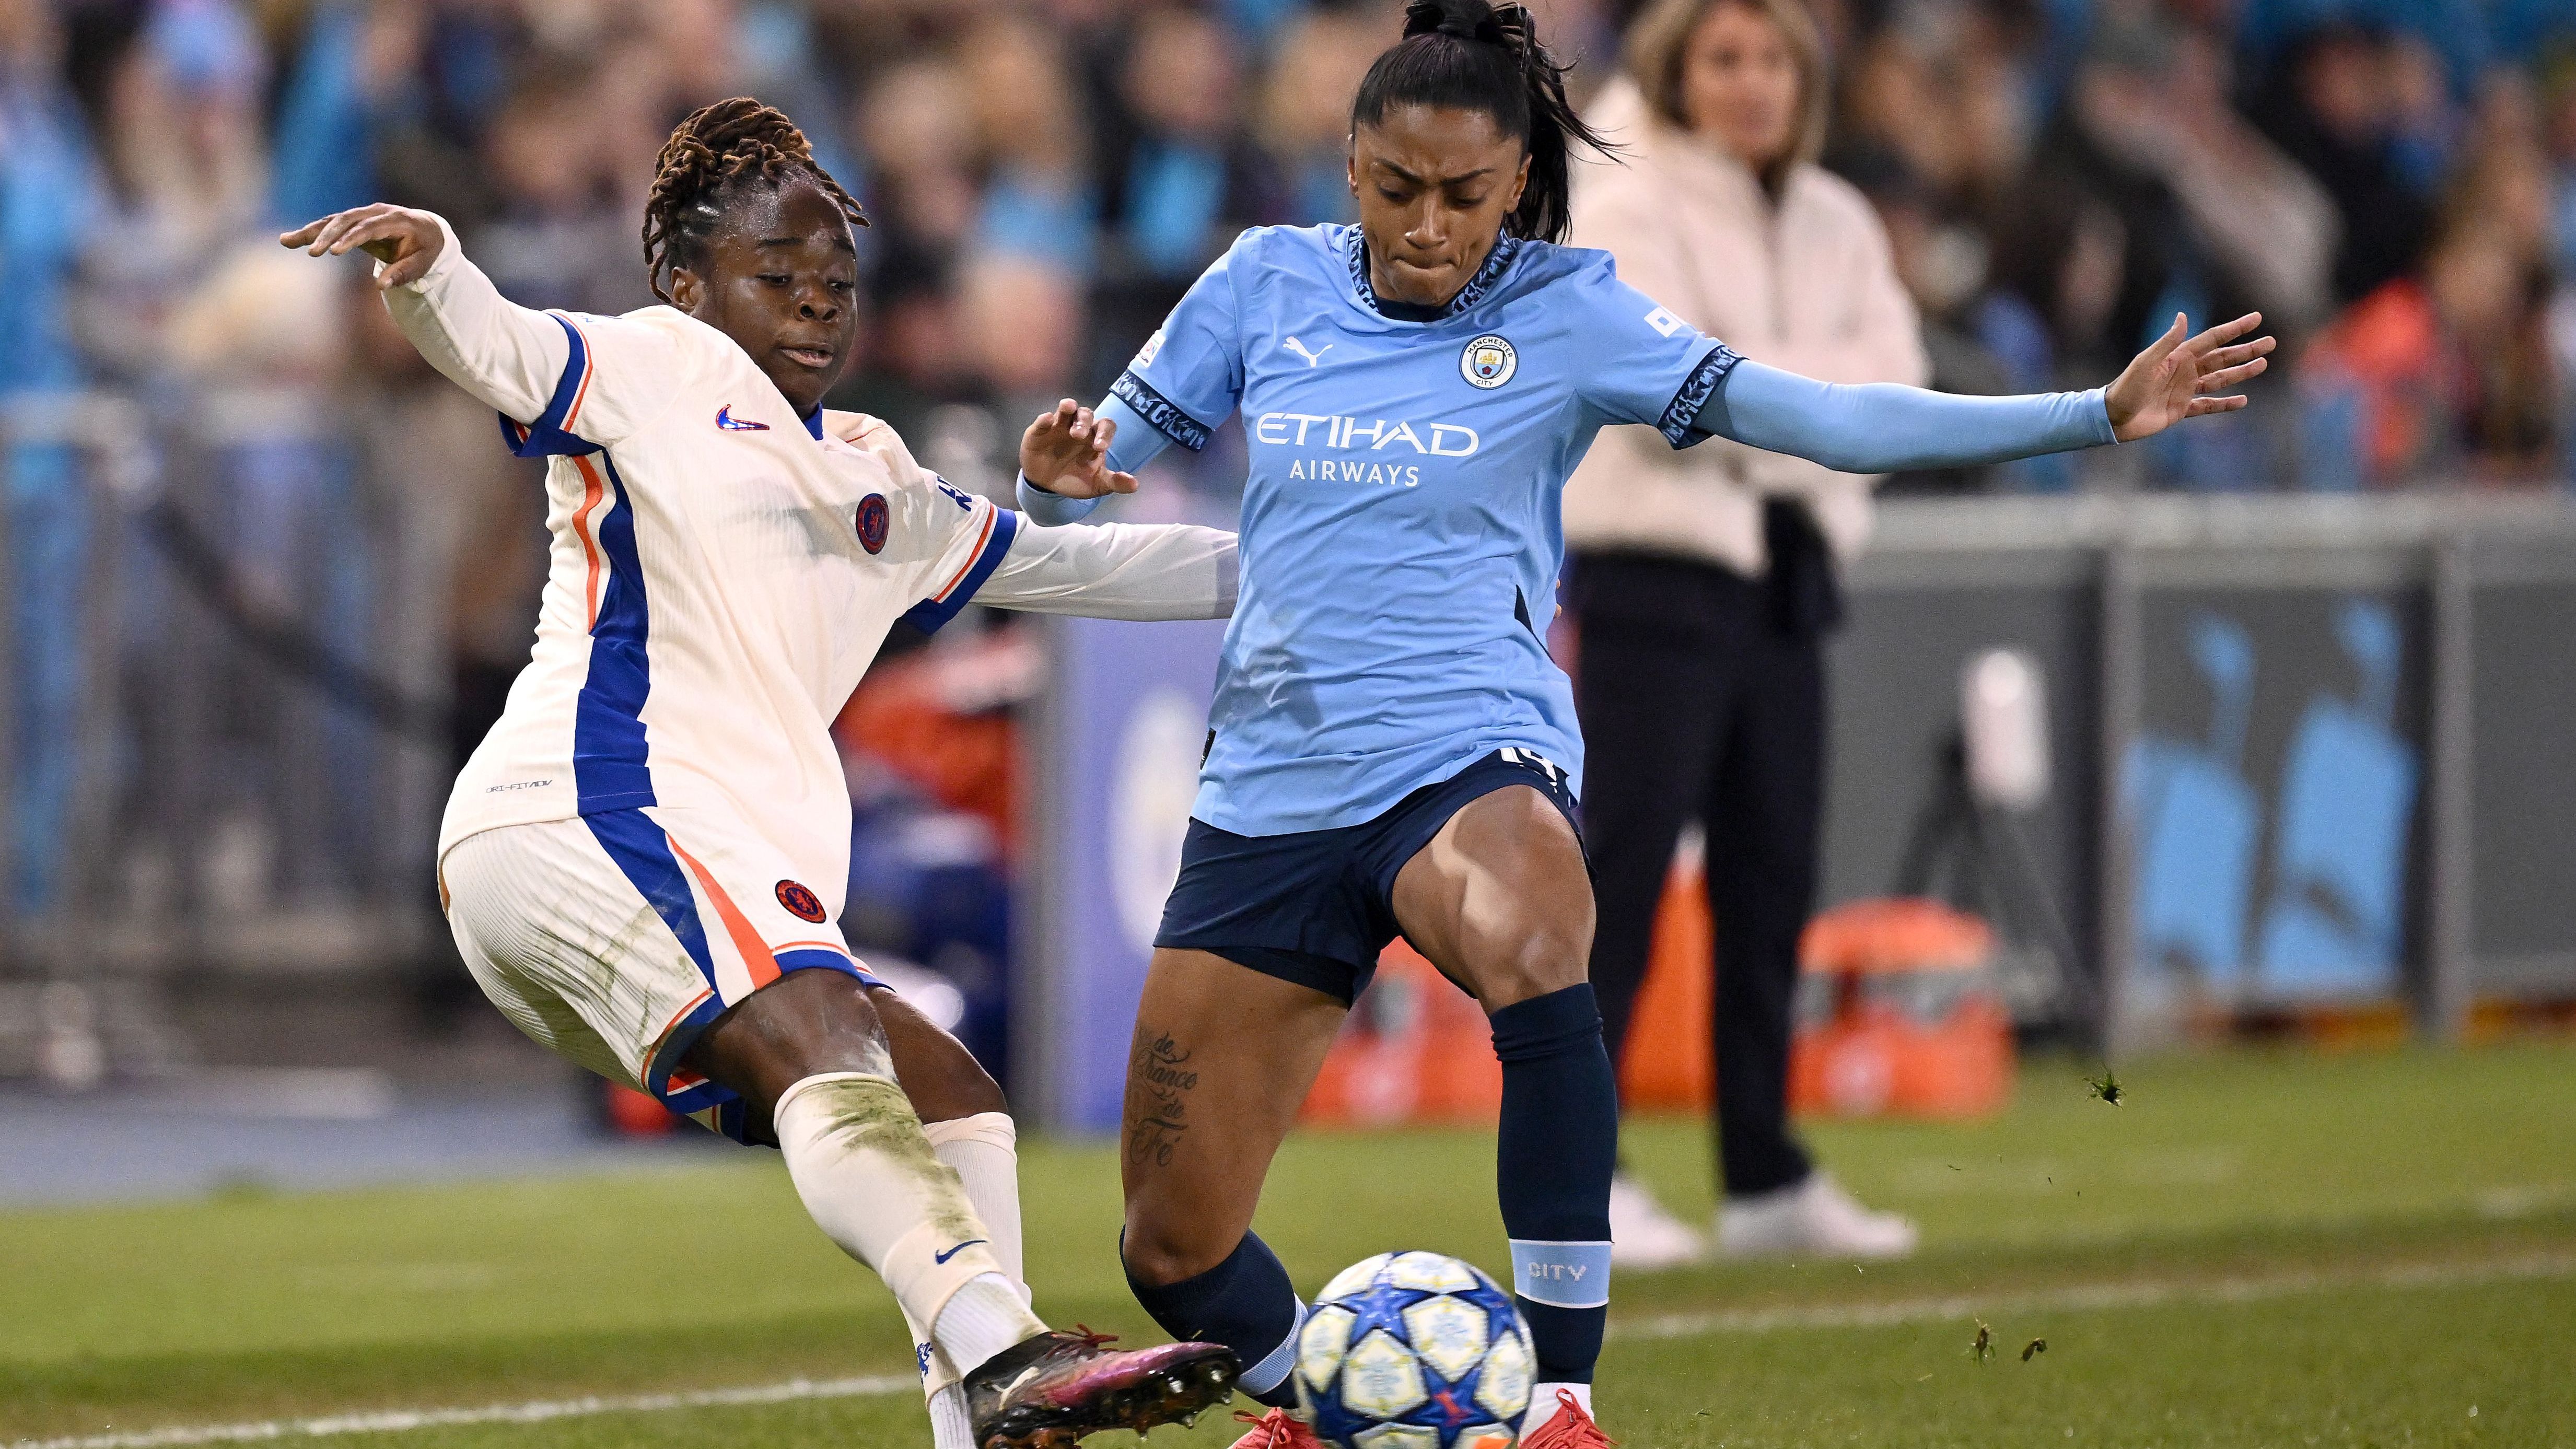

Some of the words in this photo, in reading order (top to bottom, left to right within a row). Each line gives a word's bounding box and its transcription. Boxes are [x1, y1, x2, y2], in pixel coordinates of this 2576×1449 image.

[1467, 338, 1513, 357] MANCHESTER
[1256, 412, 1479, 457] ETIHAD
[1289, 459, 1419, 487] AIRWAYS
[1529, 1261, 1587, 1281] CITY
